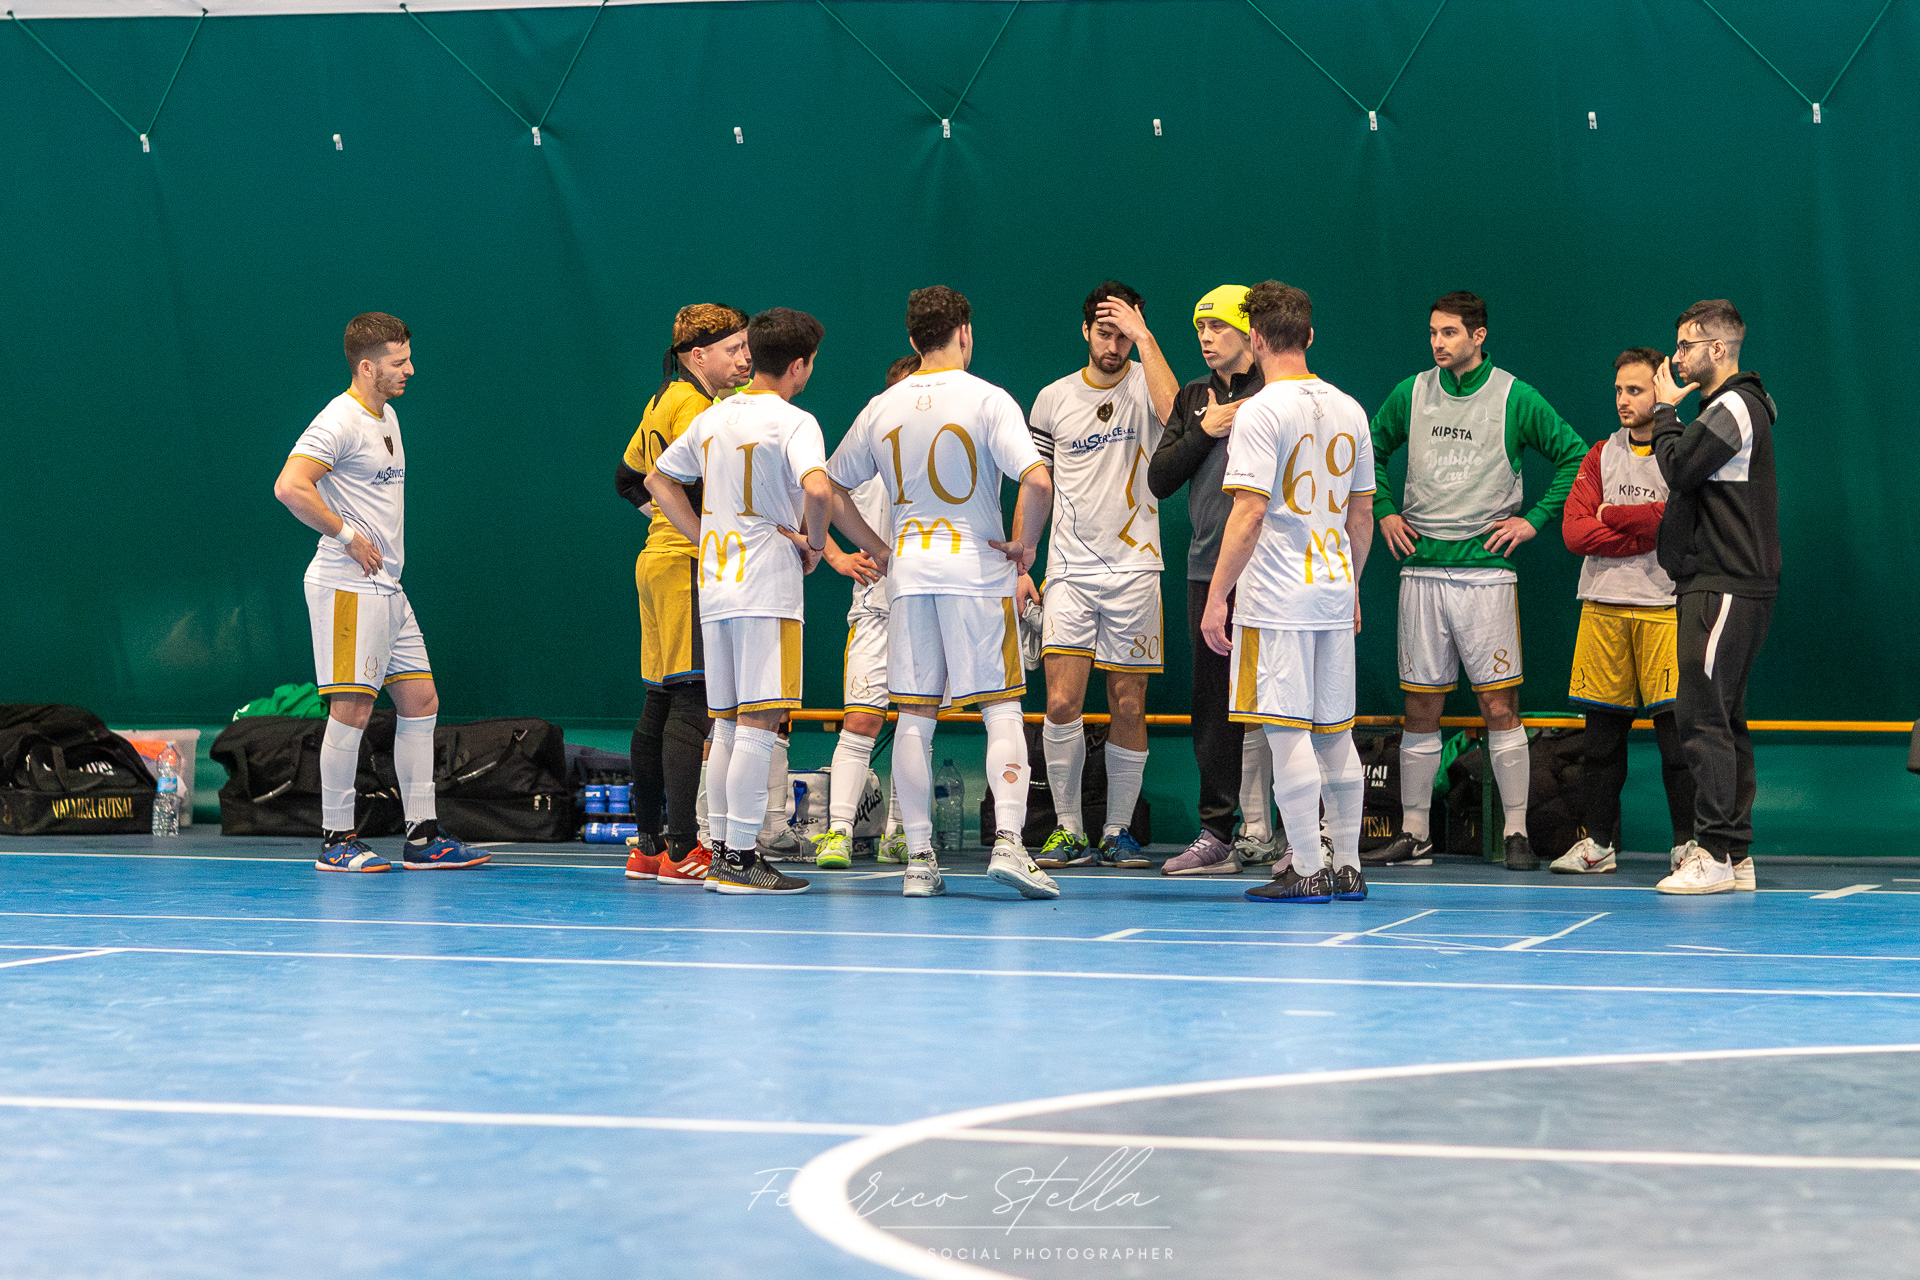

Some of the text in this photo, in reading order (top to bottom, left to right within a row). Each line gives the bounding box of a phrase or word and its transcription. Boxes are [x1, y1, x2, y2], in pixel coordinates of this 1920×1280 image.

[1431, 425, 1472, 441] KIPSTA
[700, 435, 764, 518] 11
[881, 422, 978, 506] 10
[1282, 432, 1356, 515] 69
[1129, 634, 1159, 660] 80
[1493, 648, 1511, 674] 8
[98, 797, 133, 819] FUTSAL
[1363, 816, 1392, 837] TSAL
